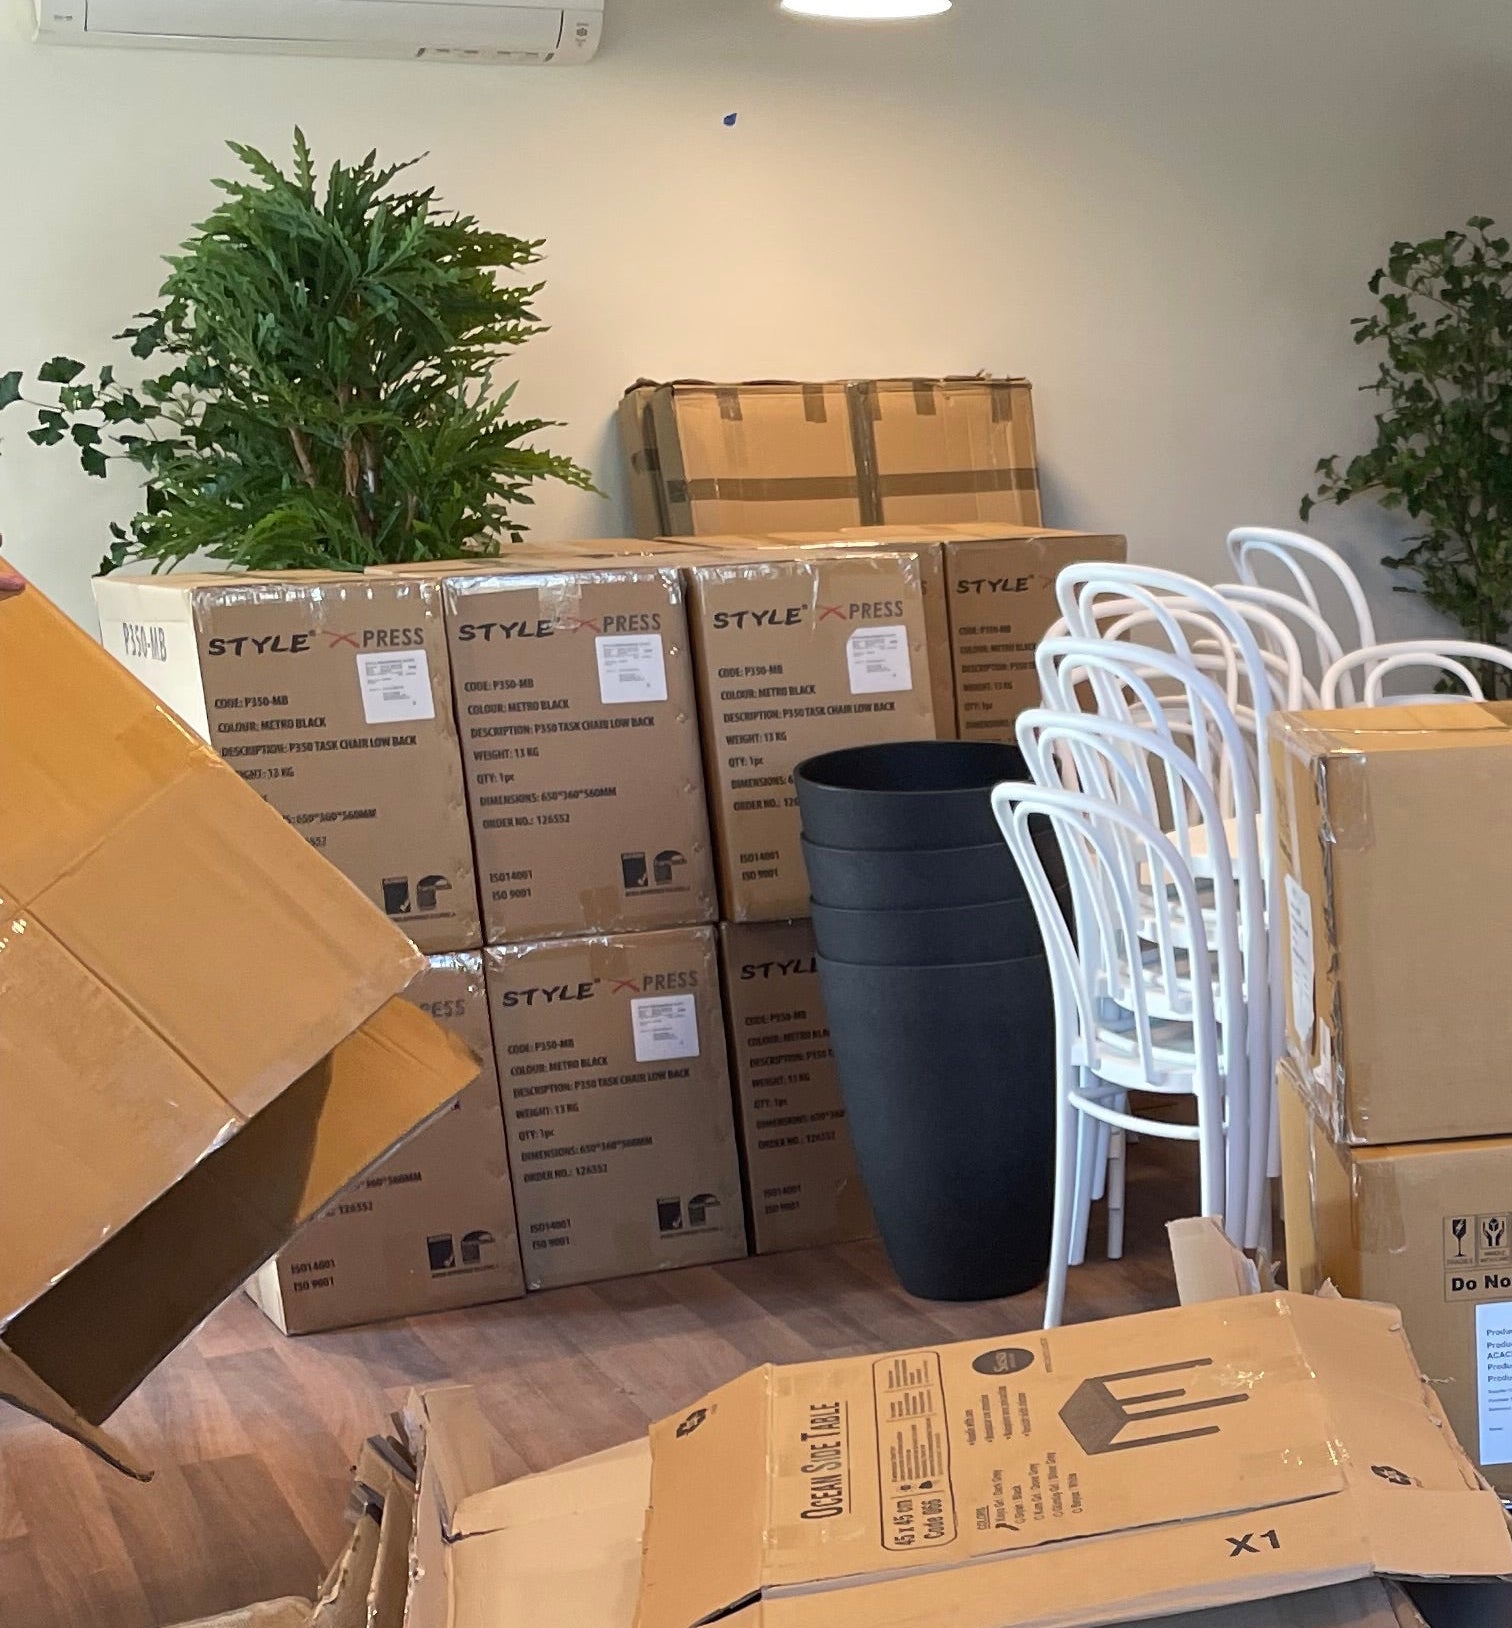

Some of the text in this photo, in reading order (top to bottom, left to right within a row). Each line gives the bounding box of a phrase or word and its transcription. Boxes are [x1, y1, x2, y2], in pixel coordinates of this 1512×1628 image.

[956, 578, 1029, 595] STYLE
[713, 608, 803, 632] STYLE
[122, 622, 168, 663] P350-MB
[207, 632, 311, 657] STYLE
[718, 667, 744, 680] CODE:
[464, 678, 535, 693] CODE: P350-MB
[721, 684, 817, 701] COLOUR: METRO BLACK
[244, 695, 289, 707] P350-MB
[467, 698, 570, 716] COLOUR: METRO BLACK
[723, 702, 896, 724] DESCRIPTION: P350 TASK CHAIR LOW BACK
[470, 716, 655, 740] DESCRIPTION: P350 TASK CHAIR LOW BACK
[474, 747, 540, 762] WEIGHT: 13 KG
[477, 772, 515, 785] QTY: 1pc
[480, 793, 540, 807] DIMENSIONS:
[483, 817, 514, 830] ORDER
[536, 813, 571, 827] 126552
[502, 982, 595, 1007] STYLE
[1451, 1278, 1477, 1292] Do
[800, 1402, 843, 1519] OCEAN SIDE TABLE
[893, 1514, 914, 1526] 45
[923, 1516, 944, 1540] Code
[894, 1534, 915, 1546] 45
[1224, 1529, 1281, 1557] X1
